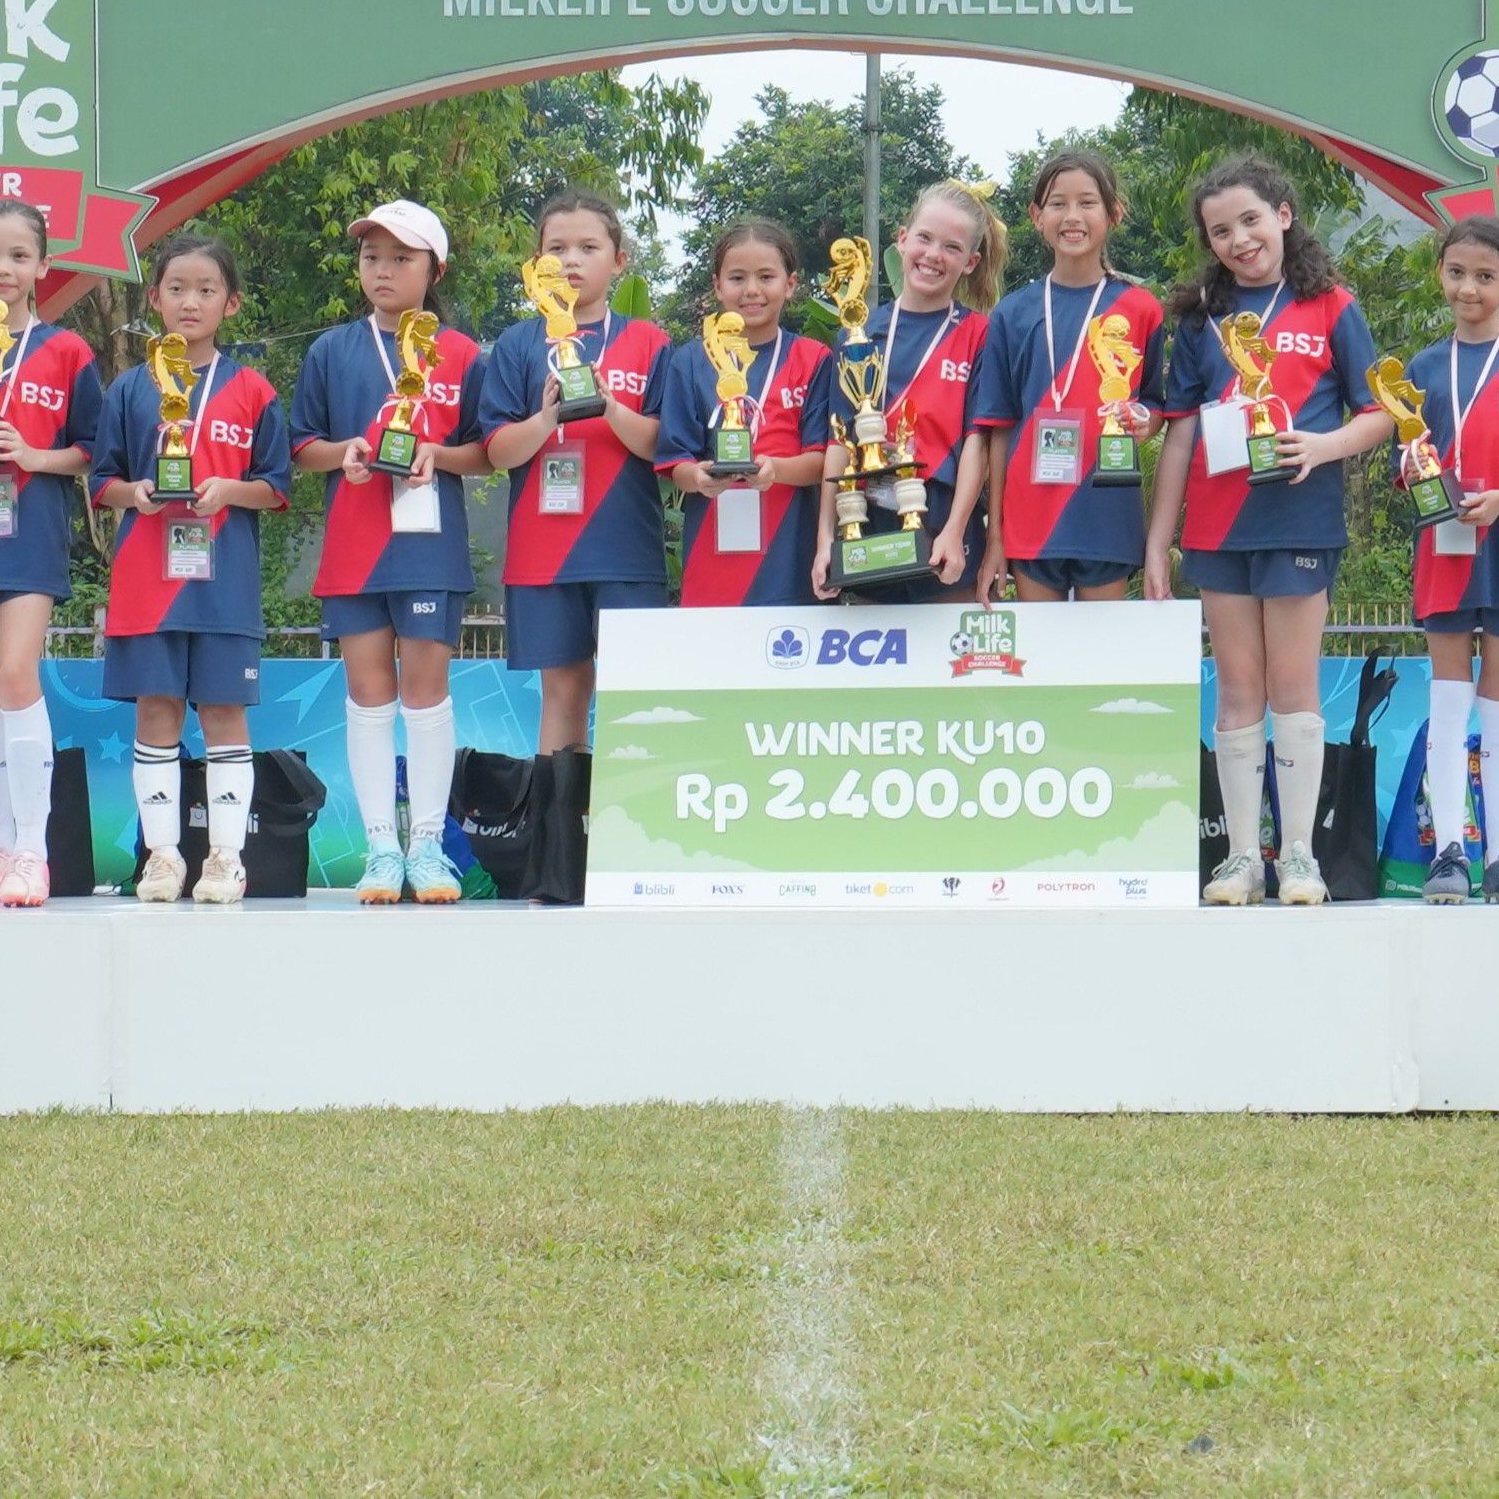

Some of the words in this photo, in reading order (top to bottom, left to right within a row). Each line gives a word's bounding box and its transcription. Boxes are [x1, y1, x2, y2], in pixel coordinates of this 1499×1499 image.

[1276, 331, 1326, 358] BSJ
[607, 369, 648, 396] BSJ
[21, 382, 65, 411] BSJ
[211, 419, 254, 449] BSJ
[1295, 556, 1318, 570] BSJ
[412, 602, 436, 614] BSJ
[966, 613, 1011, 634] Milk
[816, 628, 908, 666] BCA
[973, 633, 1013, 653] Life
[744, 720, 925, 757] WINNER
[937, 719, 1046, 765] KU10
[676, 773, 749, 833] Rp
[764, 767, 1114, 821] 2.400.000
[644, 884, 675, 896] blibli
[1037, 883, 1096, 892] POLYTRON
